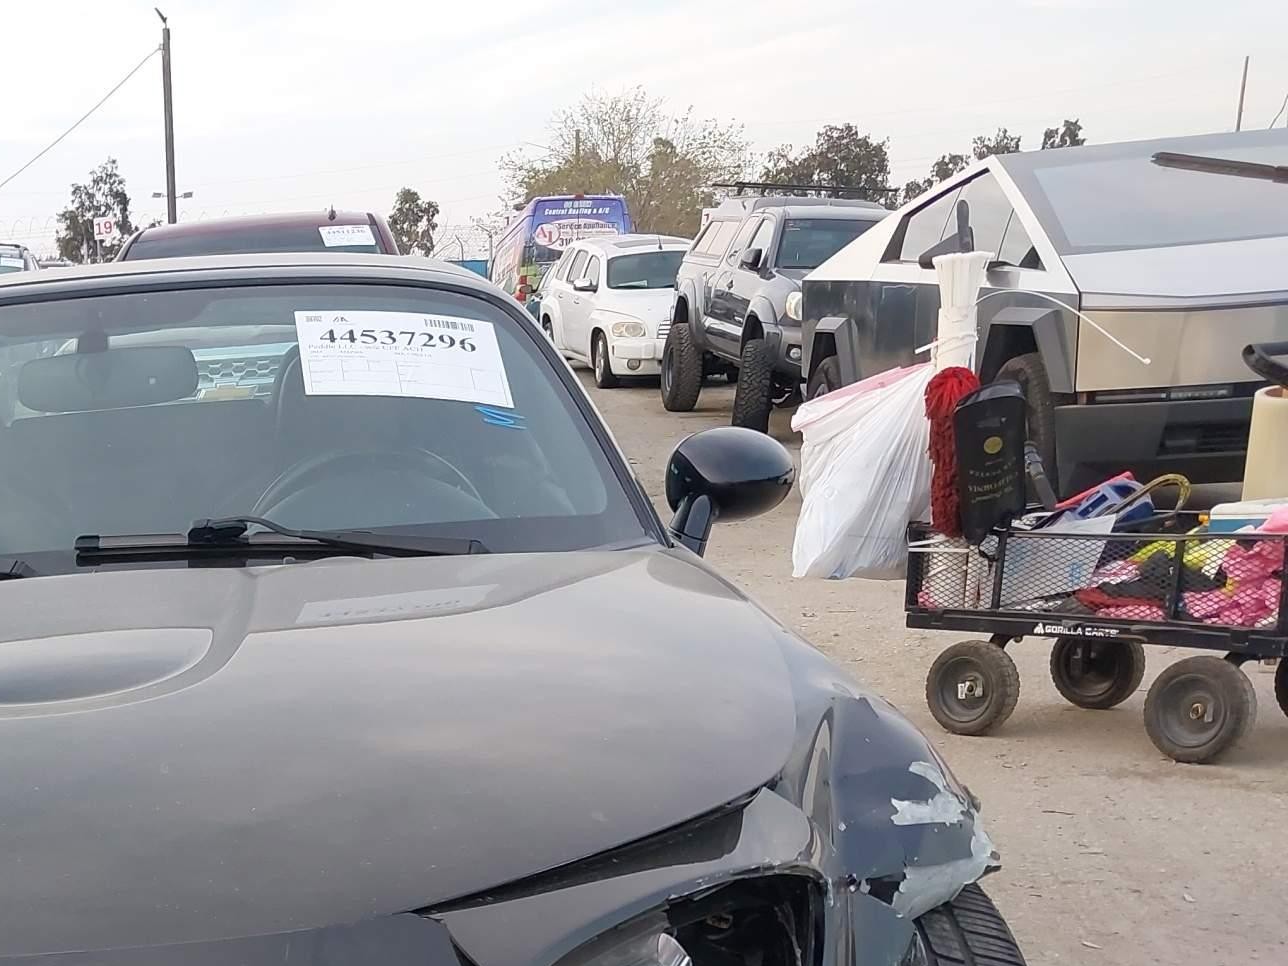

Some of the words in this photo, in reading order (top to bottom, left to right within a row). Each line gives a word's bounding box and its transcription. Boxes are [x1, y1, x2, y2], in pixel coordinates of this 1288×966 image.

[95, 220, 112, 236] 19
[320, 328, 476, 353] 44537296
[1045, 625, 1083, 635] GORILLA
[1085, 628, 1118, 637] CARTS
